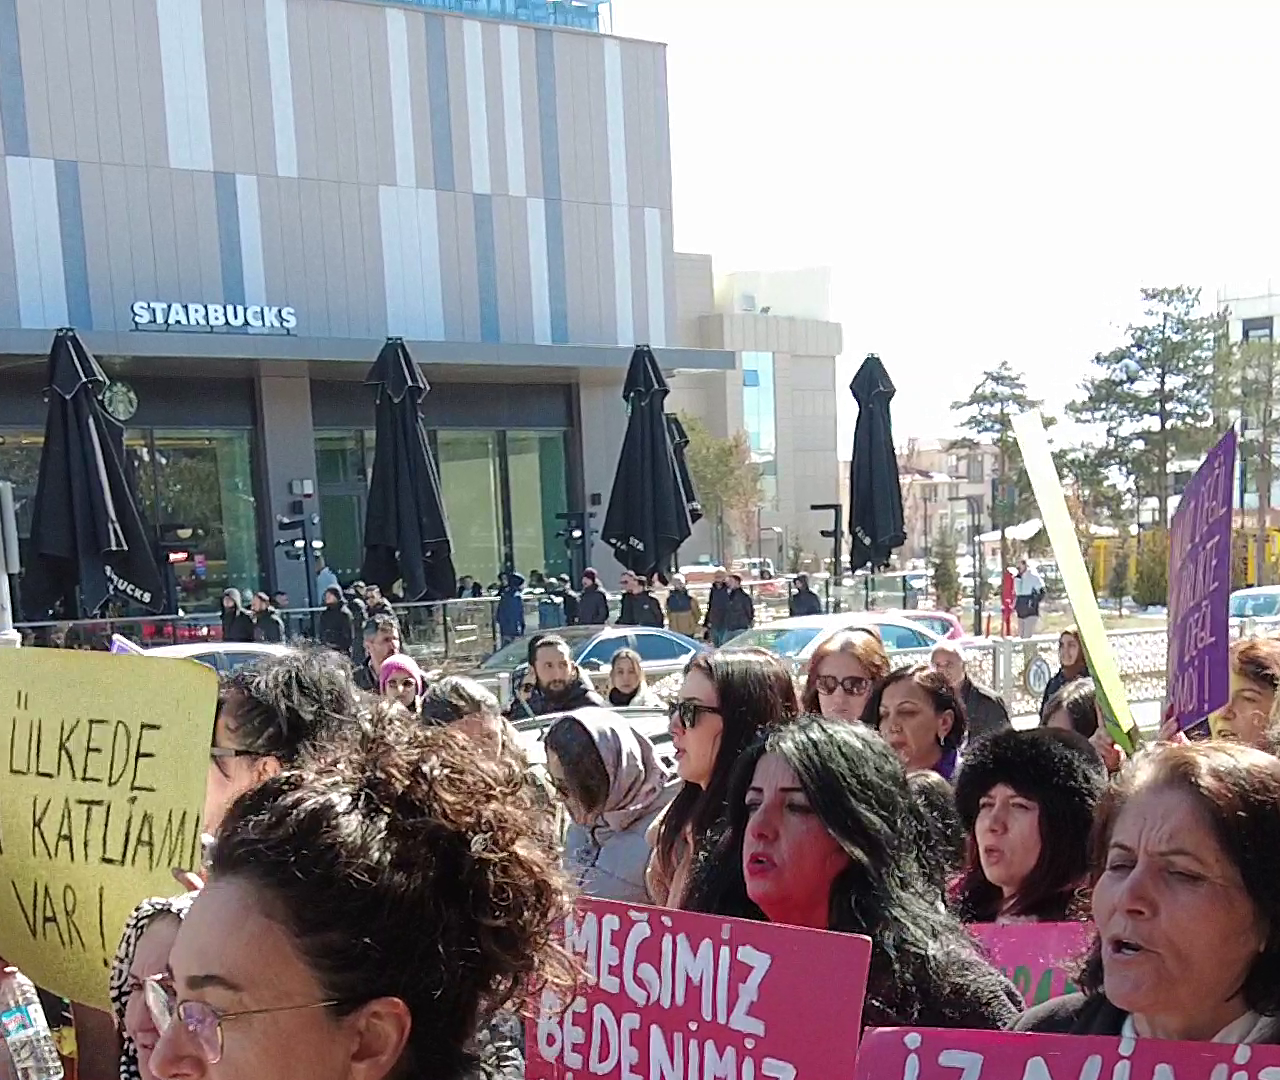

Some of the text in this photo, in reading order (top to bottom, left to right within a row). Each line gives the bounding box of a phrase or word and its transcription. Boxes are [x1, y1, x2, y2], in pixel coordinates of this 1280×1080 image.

[132, 300, 297, 329] STARBUCKS
[9, 689, 162, 793] ÜLKEDE
[563, 909, 772, 1039] MEĞİMİZ
